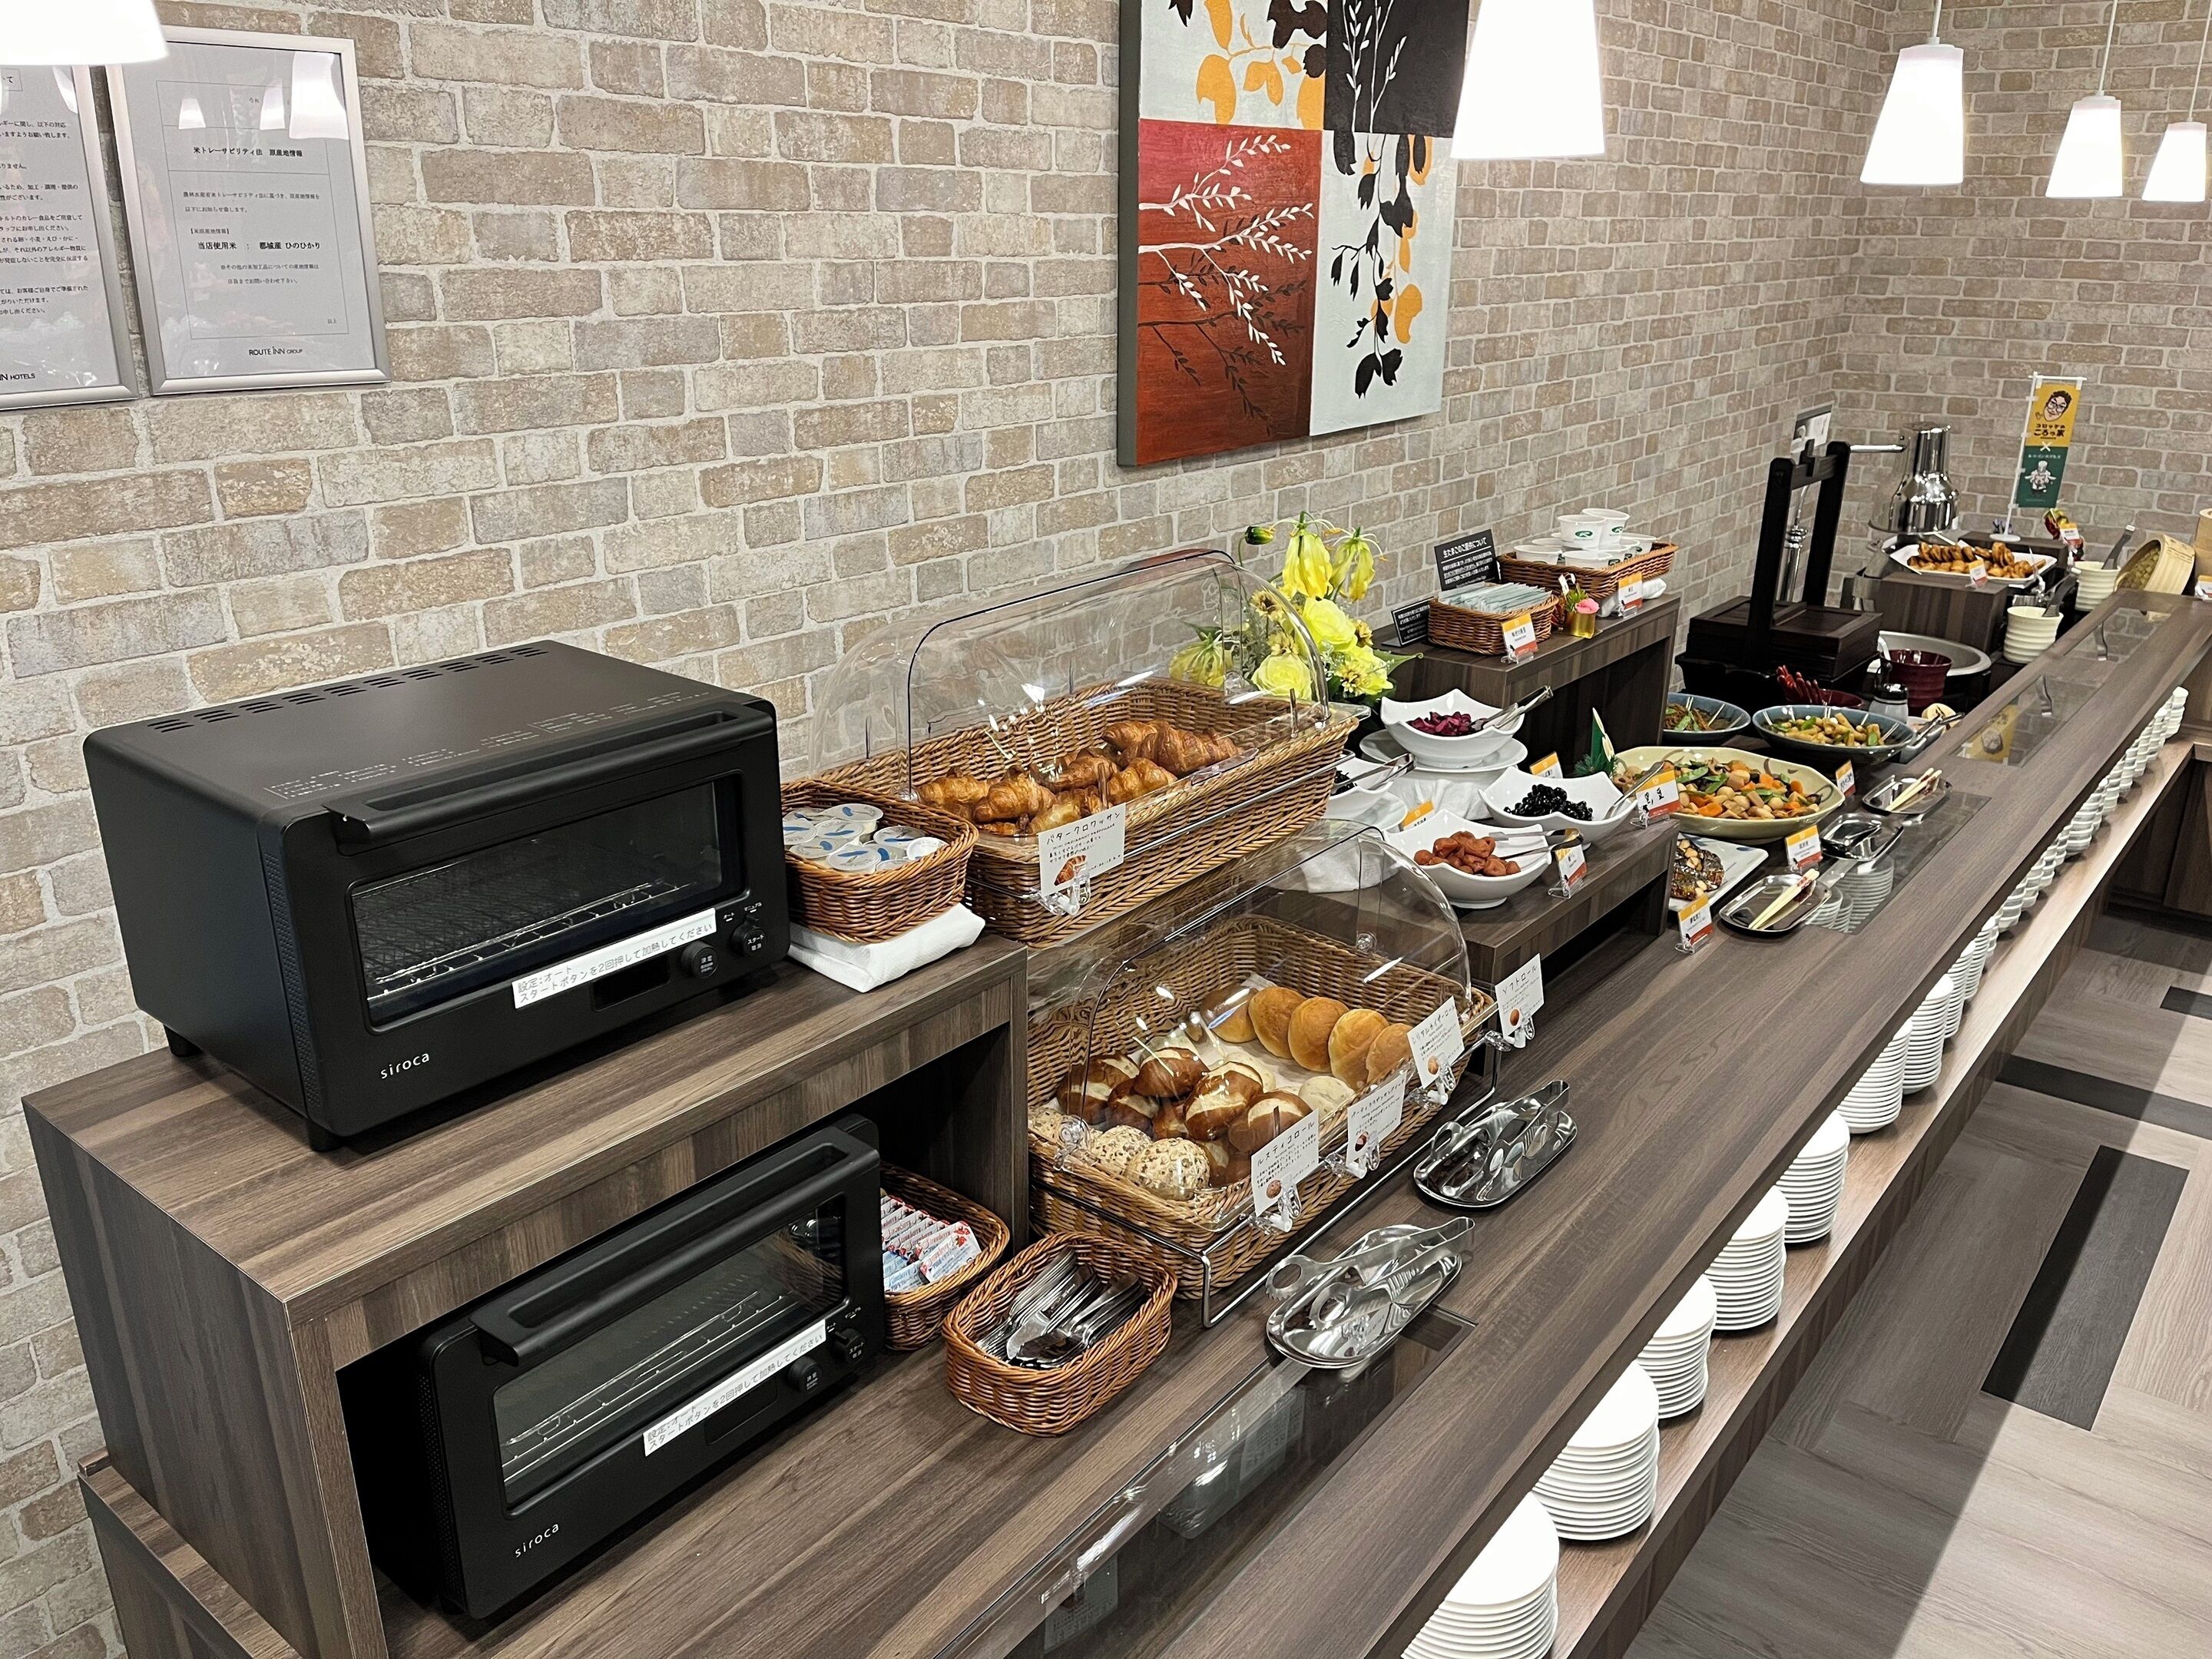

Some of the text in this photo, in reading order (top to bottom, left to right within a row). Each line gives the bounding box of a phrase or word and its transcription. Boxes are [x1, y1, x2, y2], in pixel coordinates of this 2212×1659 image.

[198, 242, 237, 250] 当店使用米
[260, 242, 282, 250] 都城産
[249, 348, 271, 356] ROUTE
[1047, 812, 1120, 845] バタークロワッサン
[520, 923, 714, 1003] スタートボタンを2回押して加熱してください
[380, 1052, 430, 1079] siroca
[1257, 1121, 1315, 1167] ルスティコロール
[650, 1333, 824, 1450] スタートボタンを2回押して加熱してください
[515, 1523, 559, 1558] siroca
